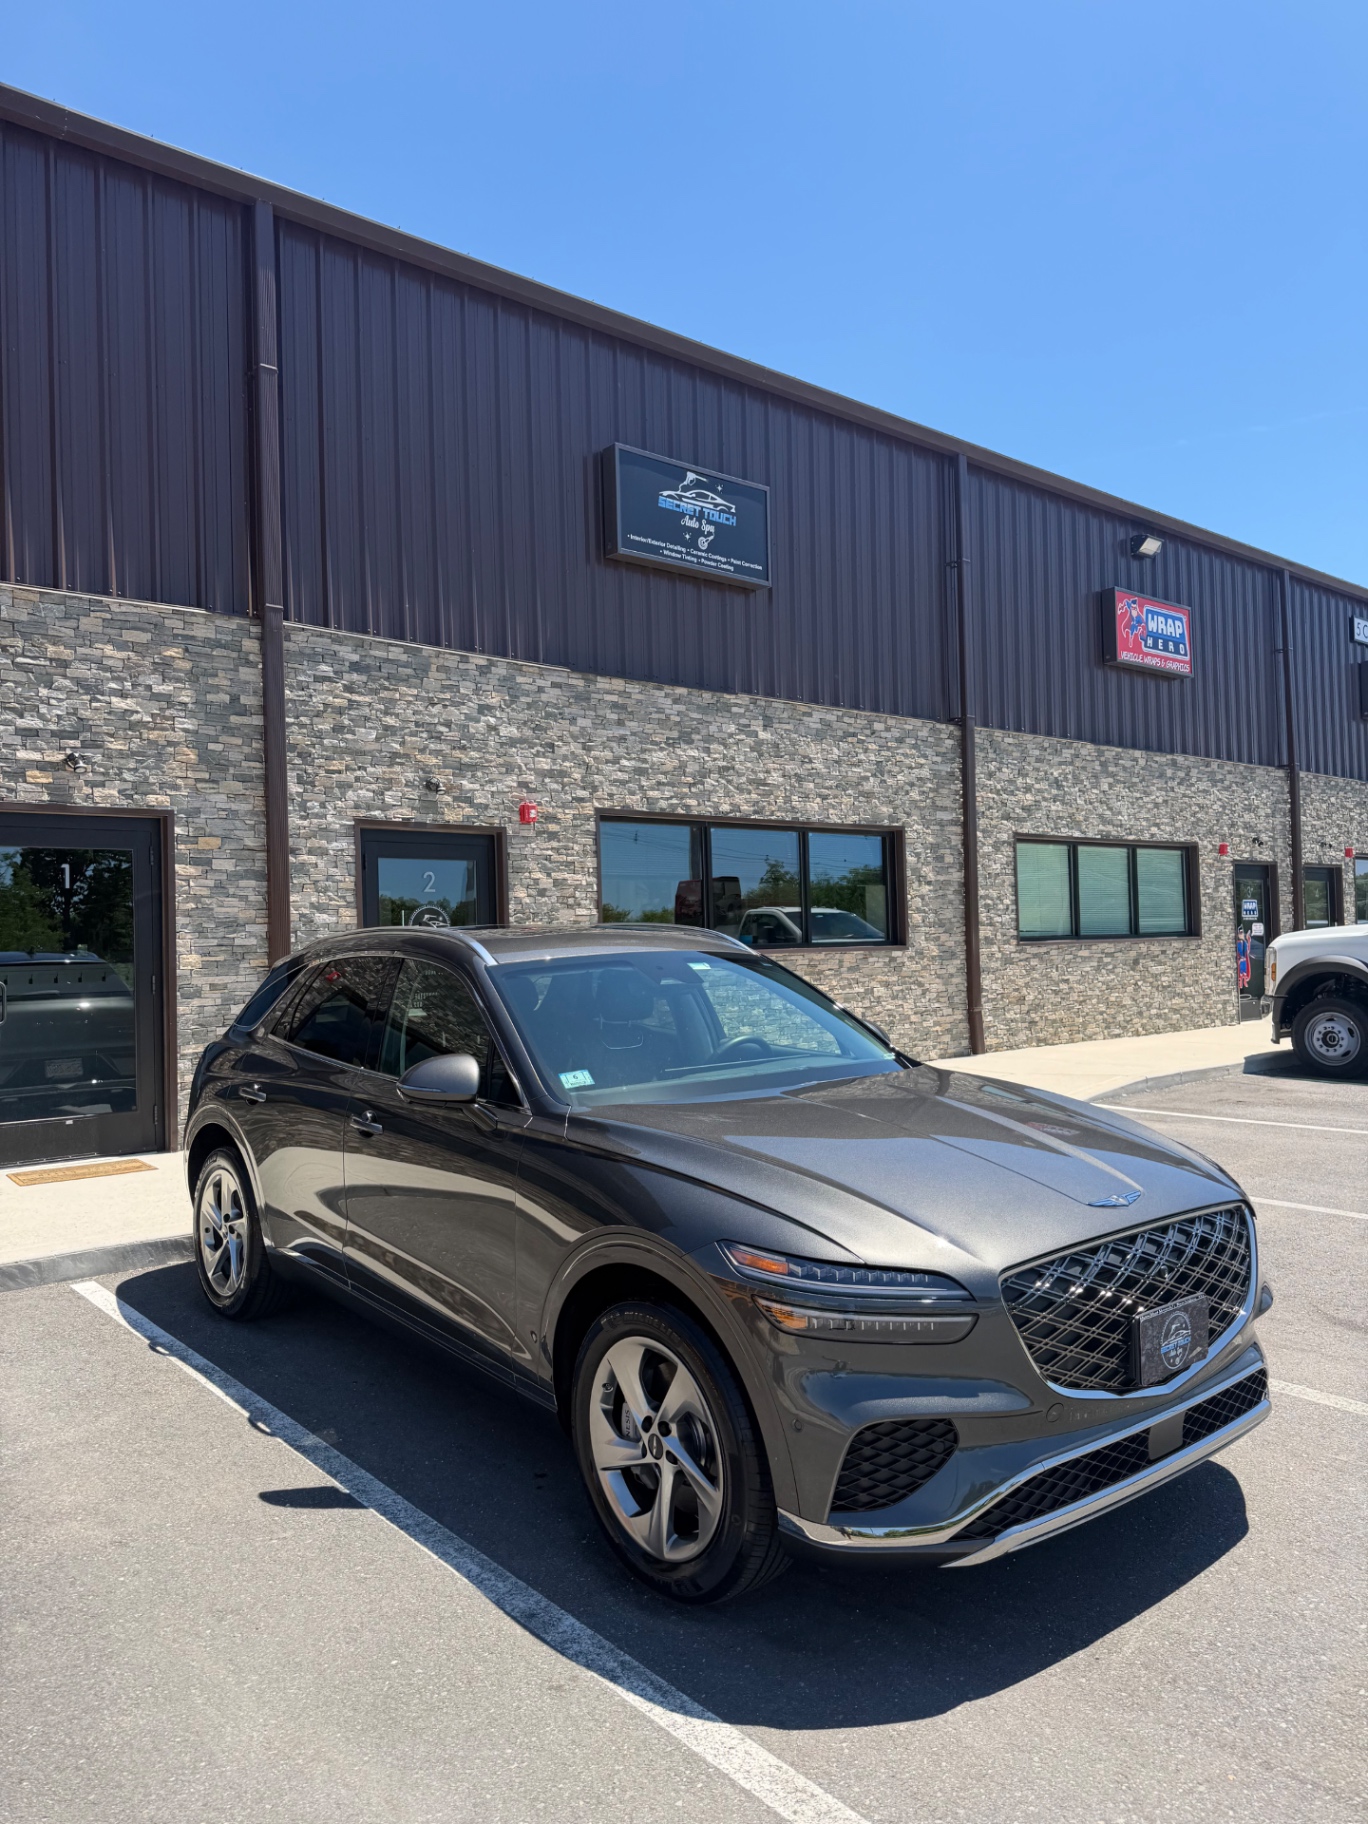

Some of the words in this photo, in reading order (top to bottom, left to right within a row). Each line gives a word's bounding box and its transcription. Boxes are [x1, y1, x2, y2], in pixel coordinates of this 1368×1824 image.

[658, 496, 701, 517] SECRET
[703, 508, 737, 526] TOUCH
[681, 515, 699, 529] Auto
[701, 519, 715, 535] Spa
[630, 534, 666, 547] Interior/Exterior
[666, 542, 686, 553] Detailing
[690, 548, 708, 558] Ceramic
[708, 553, 727, 563] Coatings
[730, 558, 741, 566] Paint
[742, 561, 763, 570] Correction
[682, 554, 697, 563] Tinting
[701, 558, 717, 567] Powder
[718, 562, 734, 572] Coating
[1148, 614, 1183, 638] WRAP
[1147, 637, 1185, 654] HERO
[1121, 650, 1143, 663] VEHICLE
[1144, 655, 1161, 667] WRAPS
[1161, 659, 1166, 667] &
[1166, 660, 1190, 672] GRAPHICS
[61, 863, 71, 889] 1
[423, 871, 436, 893] 2
